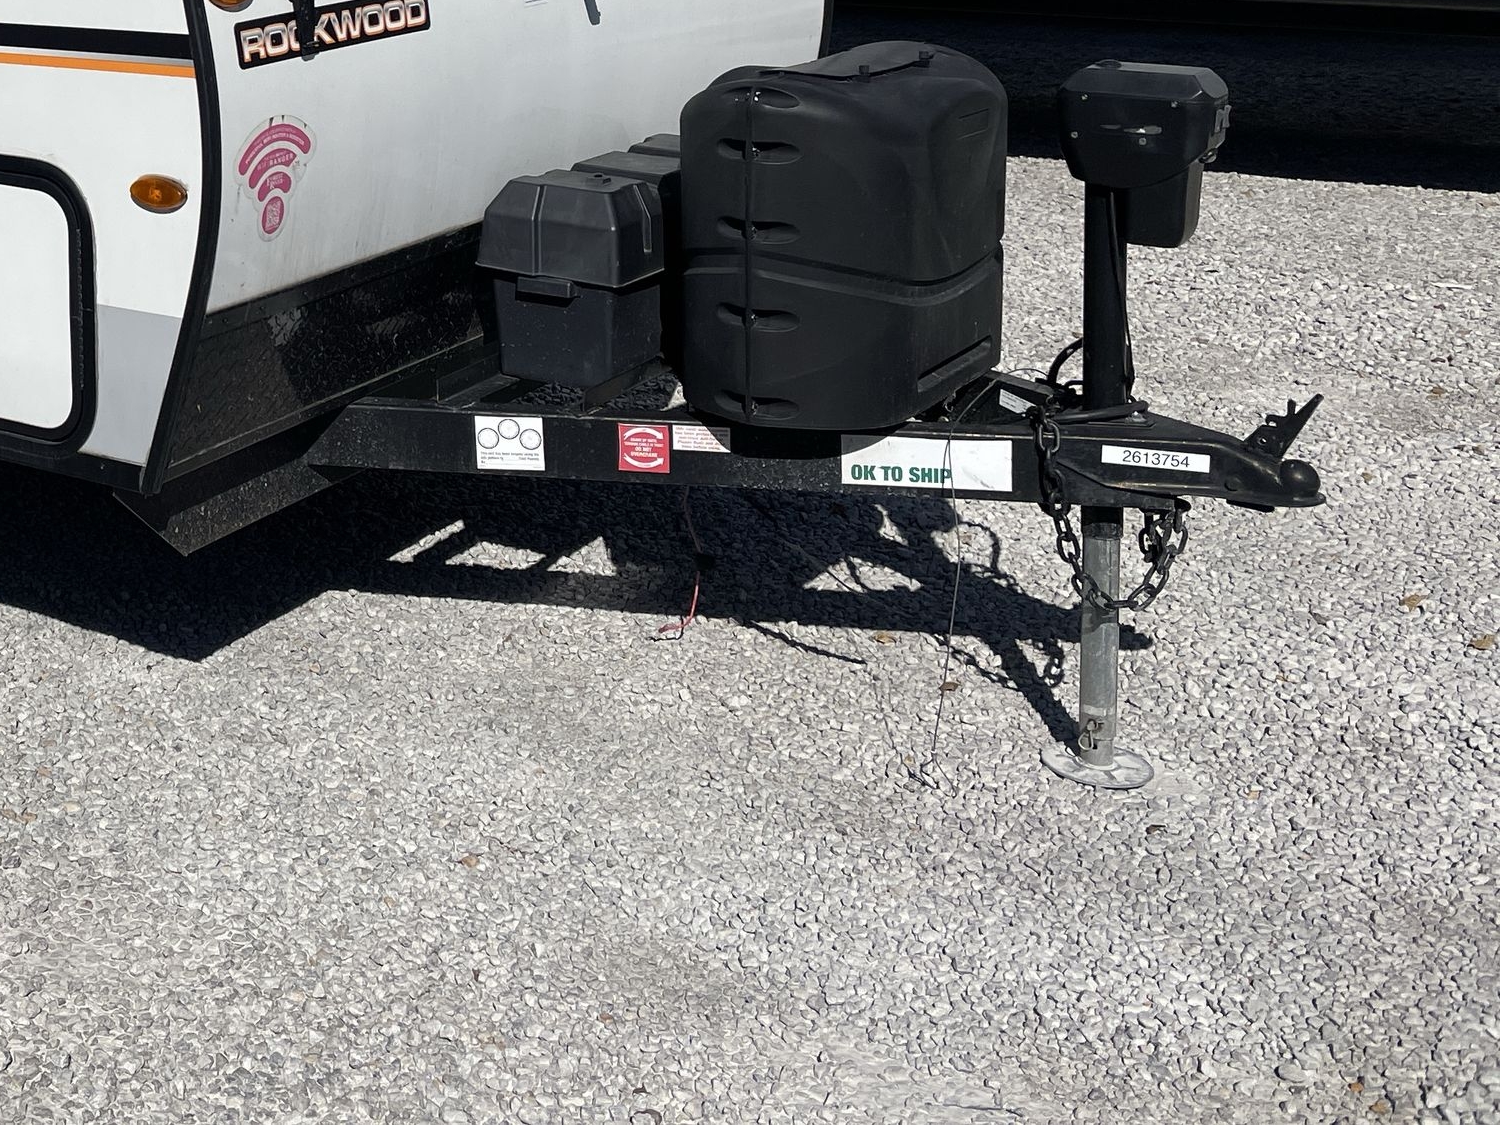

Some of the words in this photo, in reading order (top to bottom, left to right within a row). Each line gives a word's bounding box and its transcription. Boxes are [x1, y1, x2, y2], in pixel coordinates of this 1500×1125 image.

[1122, 450, 1190, 467] 2613754
[851, 464, 876, 481] OK
[879, 466, 903, 482] TO
[908, 467, 951, 484] SHIP
